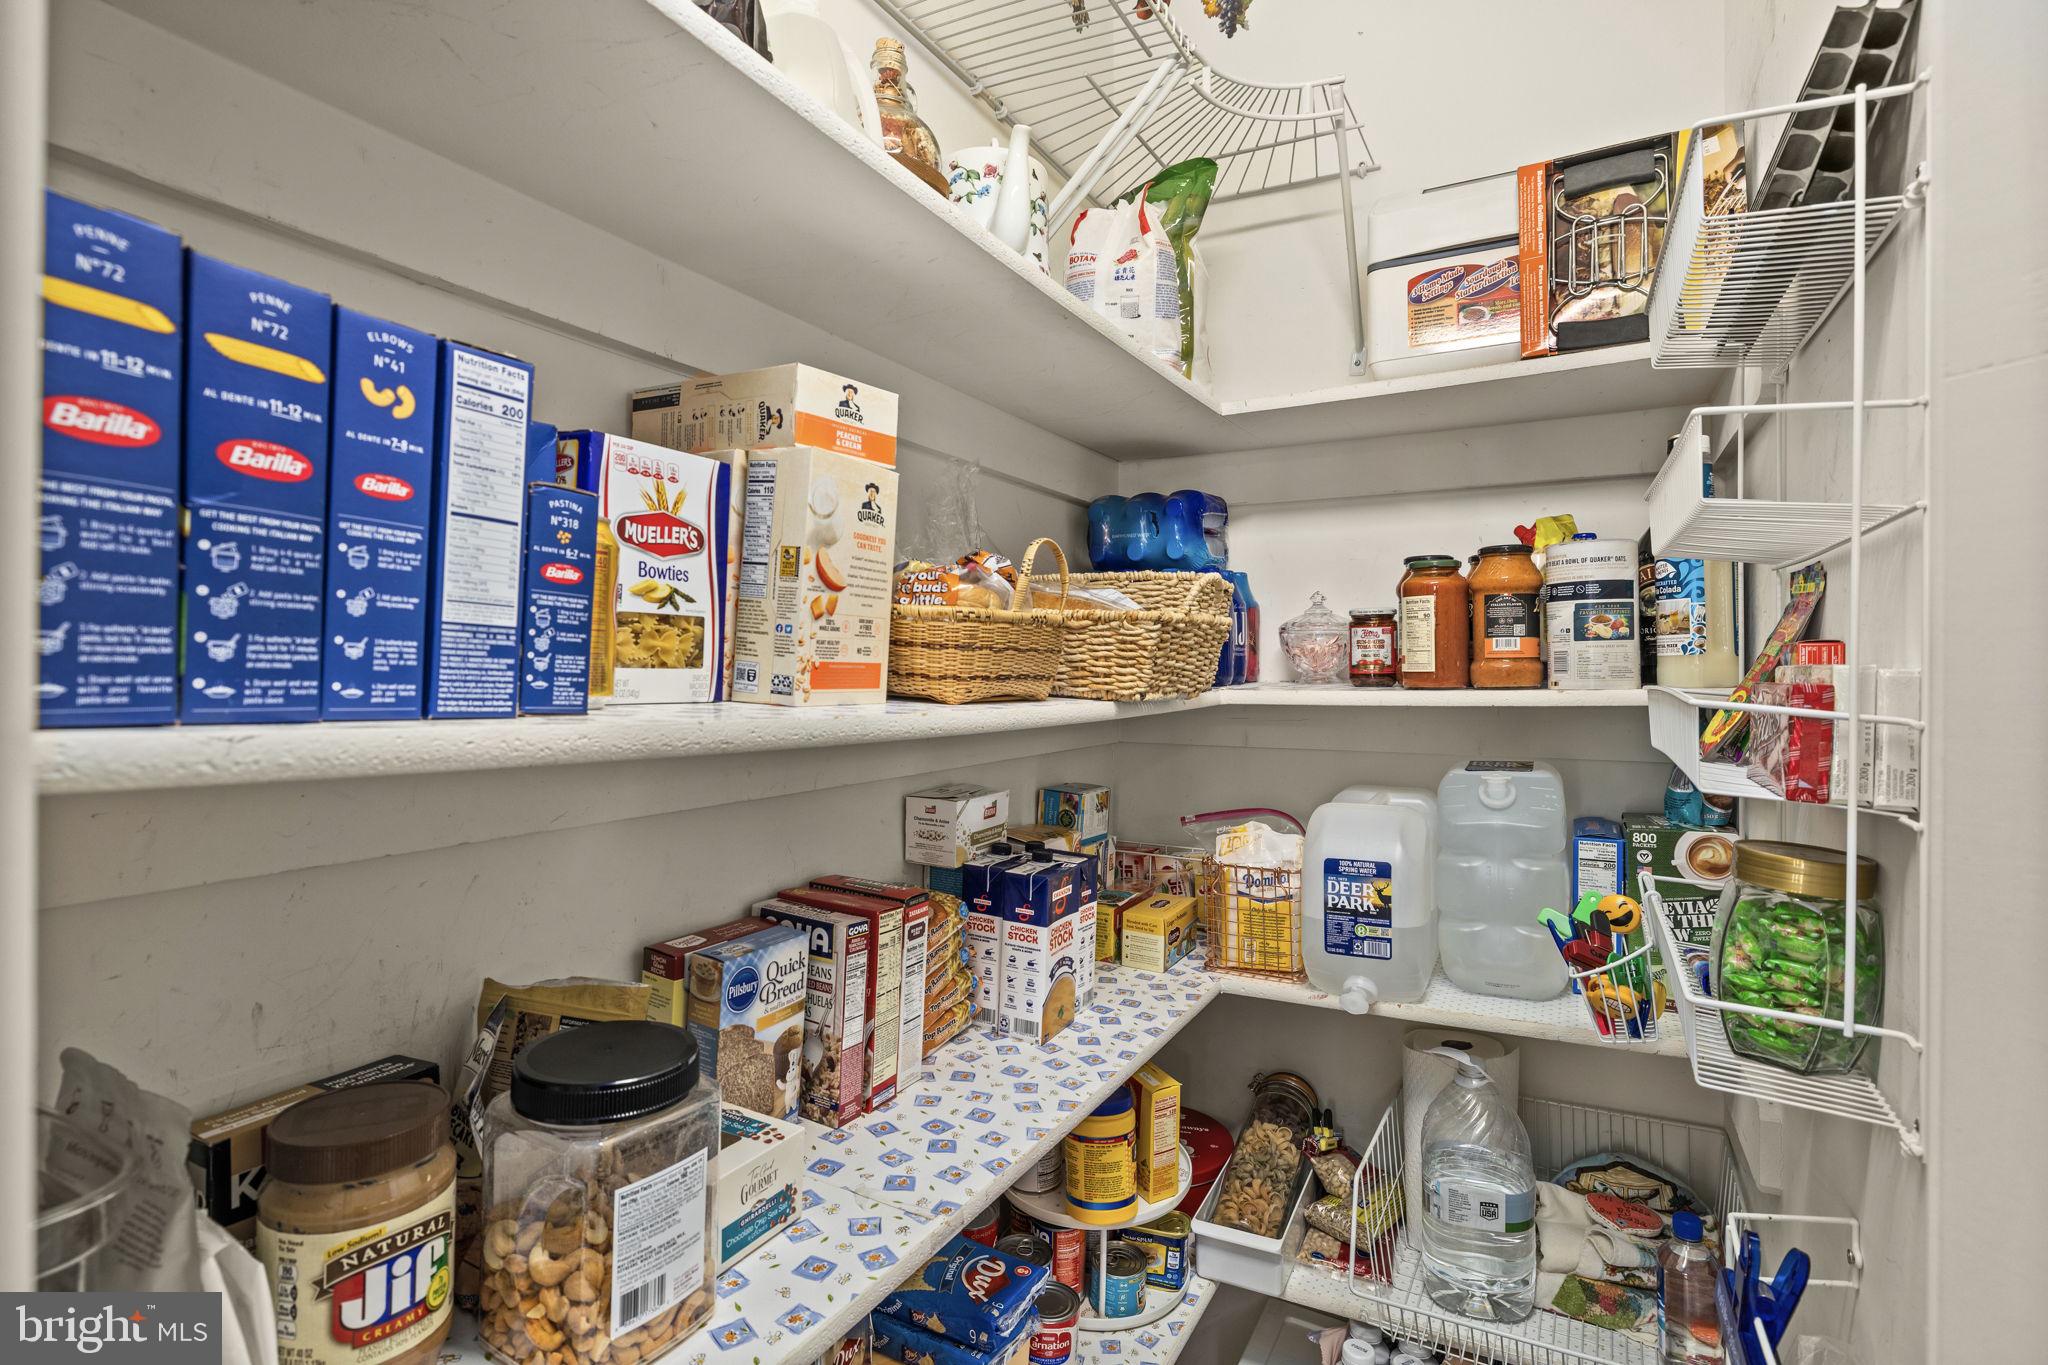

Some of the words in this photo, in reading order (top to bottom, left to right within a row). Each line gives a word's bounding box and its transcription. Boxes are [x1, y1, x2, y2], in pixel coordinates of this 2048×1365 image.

[73, 223, 130, 251] PENNE
[1069, 256, 1097, 265] BOTAN
[1419, 279, 1439, 292] Home
[1441, 267, 1464, 281] Made
[1466, 259, 1507, 285] Sourdough
[1455, 282, 1482, 300] Starter
[1481, 265, 1518, 287] function
[1422, 281, 1453, 302] Settings
[249, 291, 292, 314] PENNE
[366, 331, 415, 354] ELBOWS
[100, 349, 145, 371] 11-12
[457, 354, 499, 373] Nutrition
[502, 367, 525, 381] Facts
[270, 398, 303, 420] 11-12
[456, 395, 494, 412] Calories
[502, 405, 524, 420] 200
[834, 407, 864, 424] QUAKER
[49, 401, 151, 440] Barilla
[836, 430, 862, 442] PEACHES
[391, 437, 408, 453] 7-8
[842, 441, 862, 451] CREAM
[229, 444, 307, 476] Barilla
[361, 477, 409, 497] Barilla
[548, 499, 583, 514] PASTINA
[857, 511, 884, 526] QUAKER
[624, 520, 699, 550] MUELLER'S
[853, 532, 876, 543] GOODNESS
[877, 537, 886, 545] YOU
[857, 541, 867, 550] CAN
[545, 566, 580, 581] Barilla
[638, 561, 689, 583] Bowties
[908, 571, 941, 585] your
[913, 583, 948, 594] buds
[1659, 586, 1682, 594] Colada
[1859, 768, 1869, 782] 200
[1907, 772, 1916, 788] 200
[1632, 832, 1657, 843] 800
[1054, 887, 1071, 898] SWANSON
[1327, 880, 1374, 897] DEER
[1080, 905, 1095, 915] CHICKEN
[1080, 913, 1095, 924] STOCK
[931, 919, 950, 936] Ramen
[966, 922, 995, 934] STOCK
[968, 915, 994, 924] CHICKEN
[1051, 920, 1072, 934] CHICKEN
[848, 925, 868, 935] GOYA
[1008, 932, 1038, 944] STOCK
[1010, 925, 1037, 935] CHICKEN
[1049, 929, 1074, 951] STOCK
[651, 954, 667, 963] LEMON
[930, 944, 949, 959] Ramen
[651, 967, 666, 976] RECIPE
[767, 952, 805, 984] Quick
[729, 981, 759, 999] Pillsbury
[760, 972, 804, 1005] Bread
[817, 982, 833, 993] BEANS
[930, 1002, 941, 1012] Top
[941, 987, 959, 1005] Ramen
[923, 1032, 936, 1041] Top
[937, 1018, 956, 1034] Ramen
[324, 1061, 393, 1087] Ingredients
[621, 1188, 640, 1200] Nutrition
[641, 1183, 652, 1192] Facts
[740, 1169, 778, 1206] GOURMET
[740, 1198, 777, 1227] GHIRARDELLI
[725, 1227, 754, 1249] Chocolate
[755, 1220, 767, 1232] Chip
[768, 1210, 777, 1221] Sea
[778, 1202, 788, 1213] Salt
[327, 1247, 344, 1258] Low
[347, 1229, 382, 1248] Sodium!
[340, 1216, 445, 1271] NATURAL
[945, 1256, 964, 1280] Original
[341, 1236, 445, 1329] Jif
[362, 1307, 424, 1342] CREAMY
[1030, 1335, 1070, 1350] Carnation
